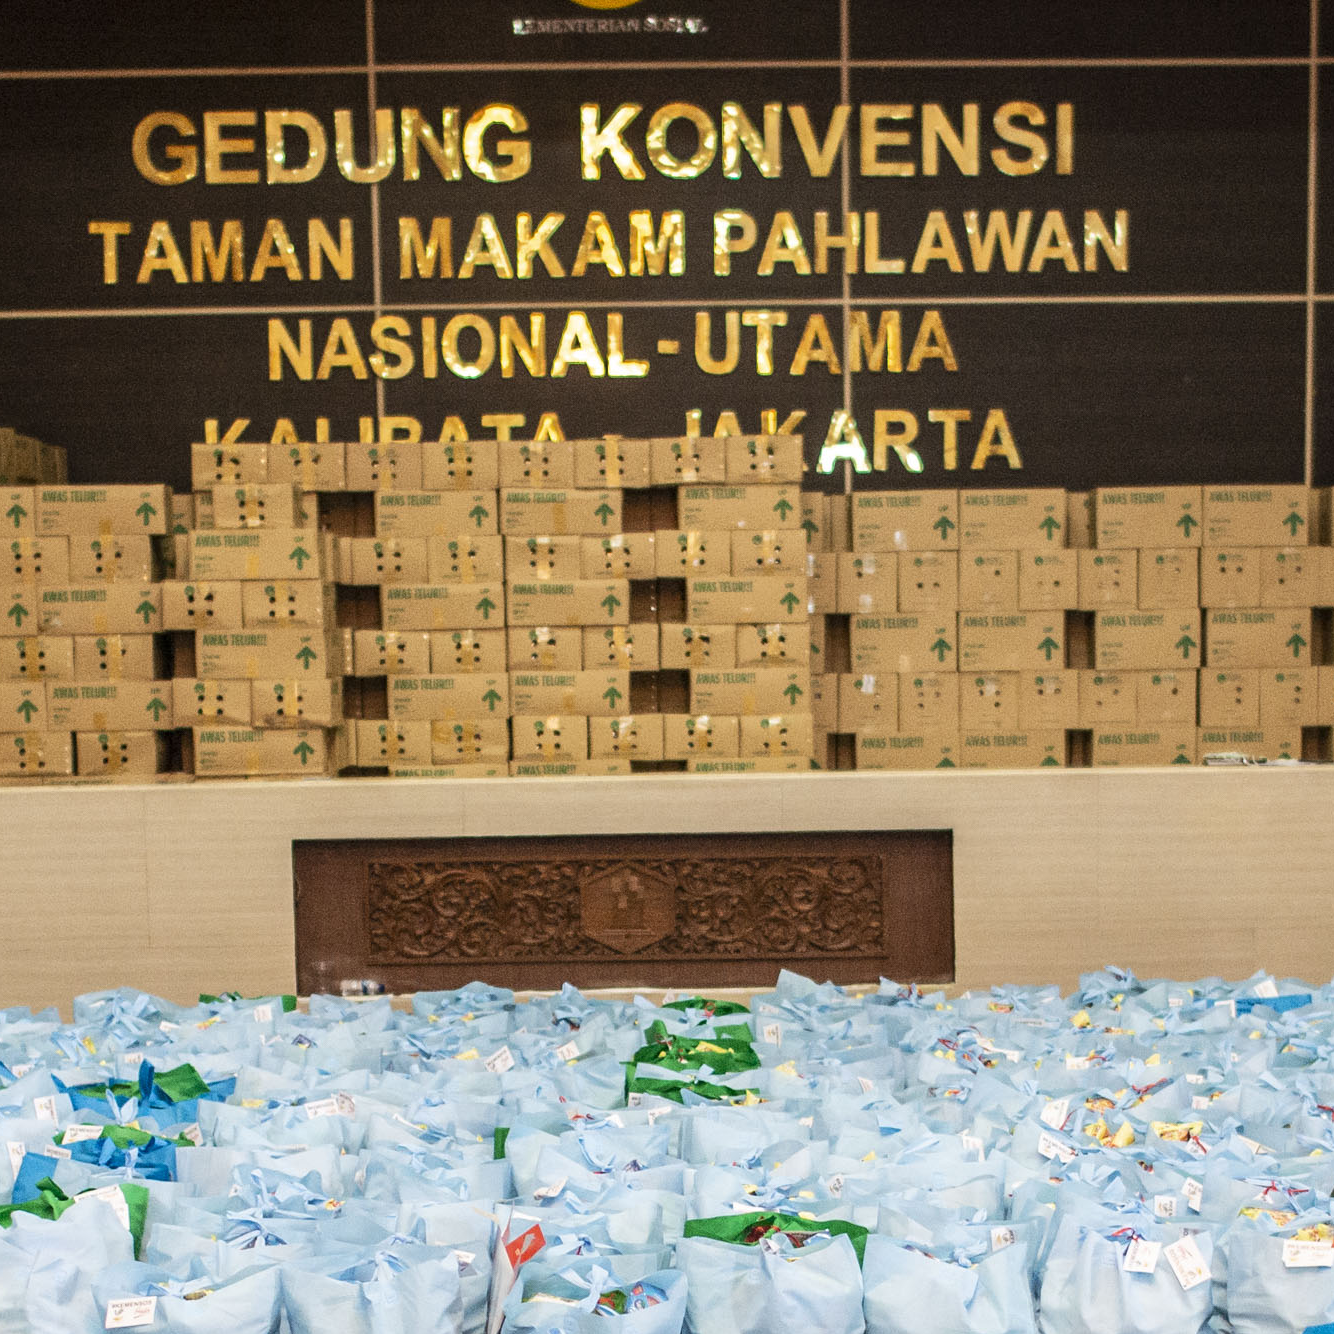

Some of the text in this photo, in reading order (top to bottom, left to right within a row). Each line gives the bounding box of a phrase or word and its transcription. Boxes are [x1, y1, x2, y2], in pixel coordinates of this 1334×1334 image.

[131, 100, 1075, 185] GEDUNG KONVENSI
[88, 208, 1130, 284] TAMAN MAKAM PAHLAWAN
